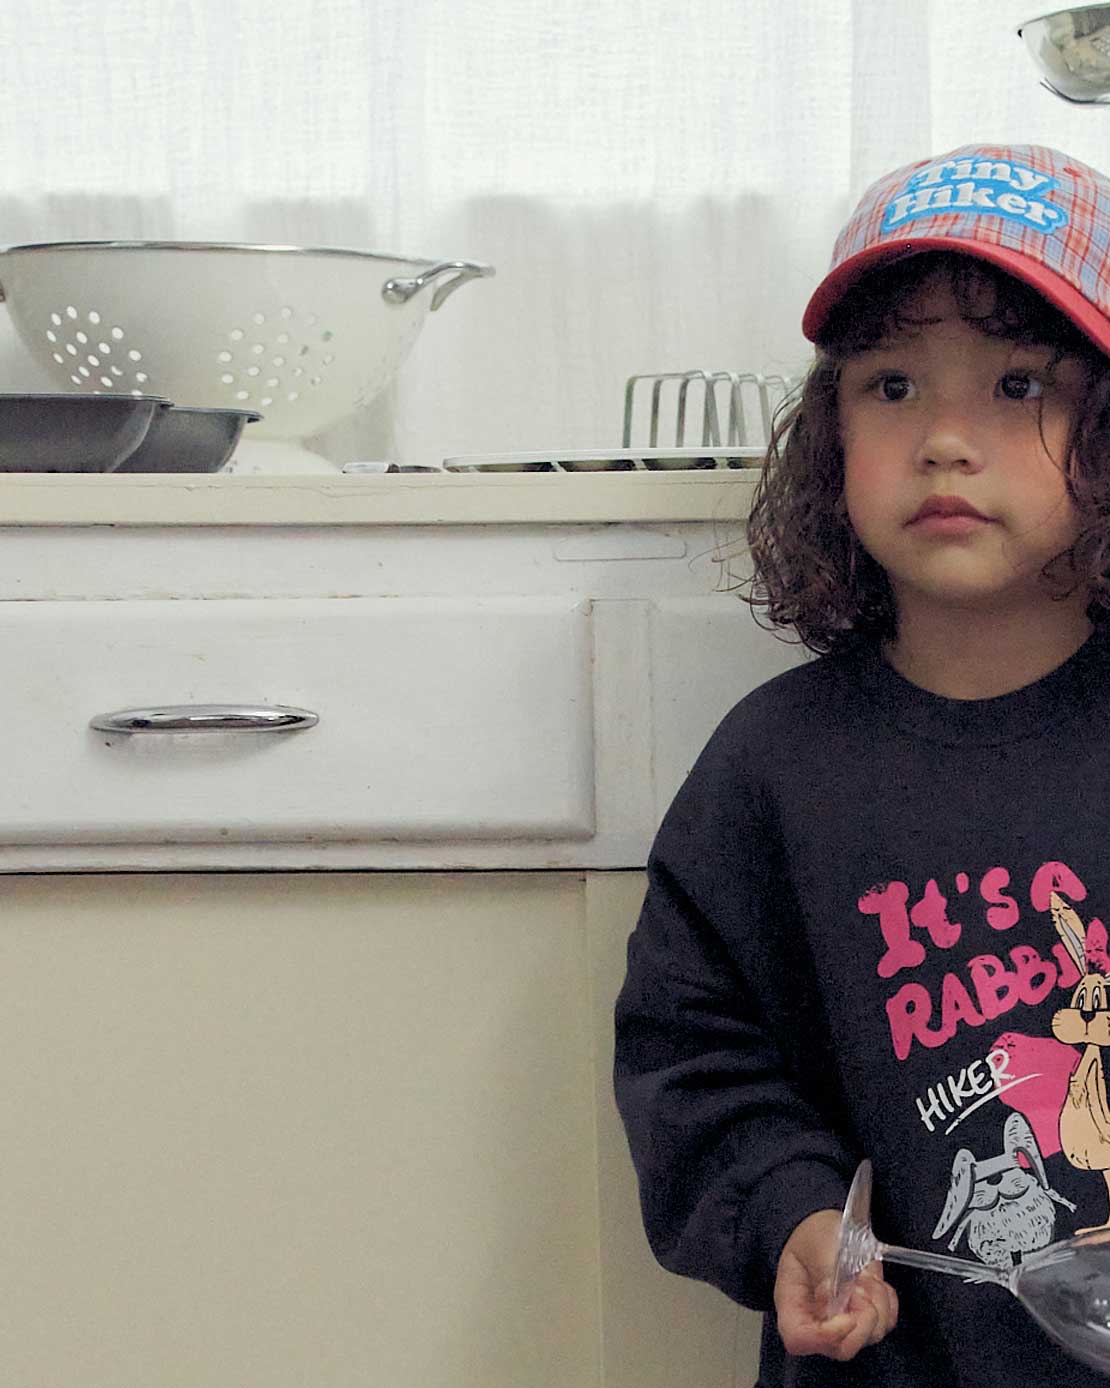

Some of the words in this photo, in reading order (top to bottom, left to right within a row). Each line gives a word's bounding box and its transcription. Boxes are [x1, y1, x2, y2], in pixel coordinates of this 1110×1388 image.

[917, 159, 1049, 191] Tiny
[888, 182, 1058, 226] Hiker
[915, 1048, 1015, 1132] HIKER
